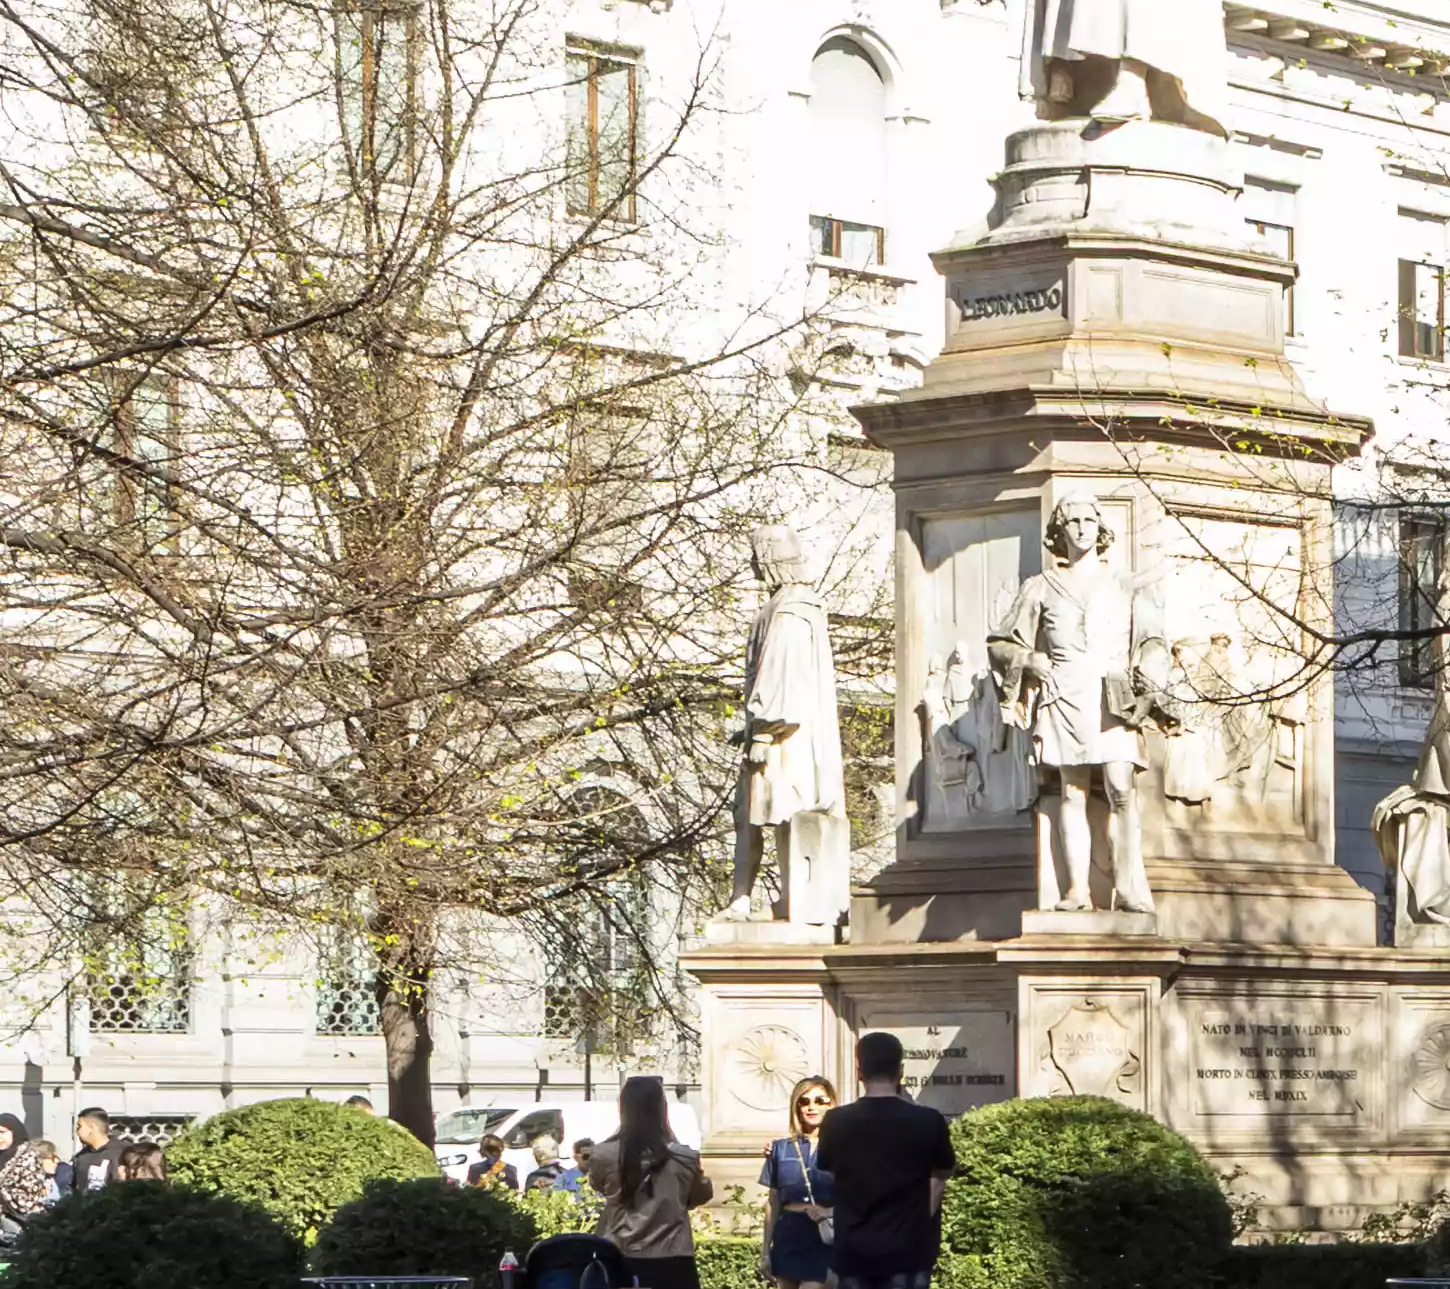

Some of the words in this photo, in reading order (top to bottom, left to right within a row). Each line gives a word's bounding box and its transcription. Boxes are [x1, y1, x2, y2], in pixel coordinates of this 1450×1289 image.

[961, 288, 1062, 322] LEONARDO
[1202, 1024, 1231, 1036] NATO
[1234, 1024, 1246, 1036] IN
[1196, 1069, 1231, 1080] MORTO
